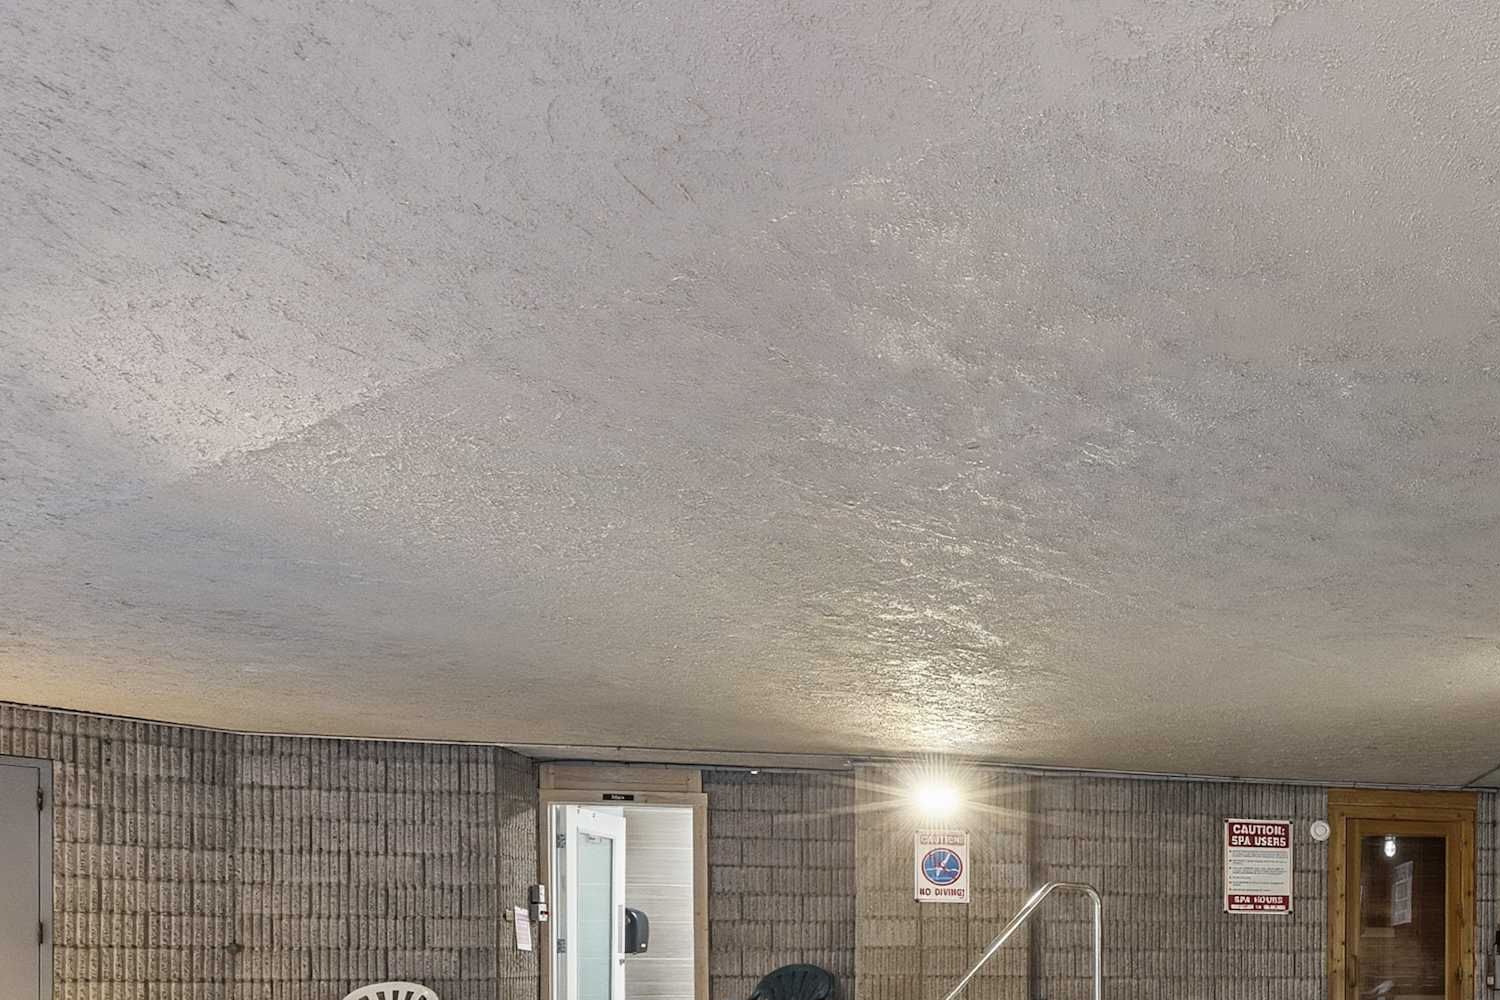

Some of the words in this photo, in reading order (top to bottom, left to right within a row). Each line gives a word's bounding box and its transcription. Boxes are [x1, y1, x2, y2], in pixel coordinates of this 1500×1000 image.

[1233, 825, 1286, 836] CAUTION:
[1231, 835, 1251, 846] SPA
[1254, 836, 1287, 847] USERS
[920, 887, 932, 896] NO
[1234, 896, 1251, 904] SPA
